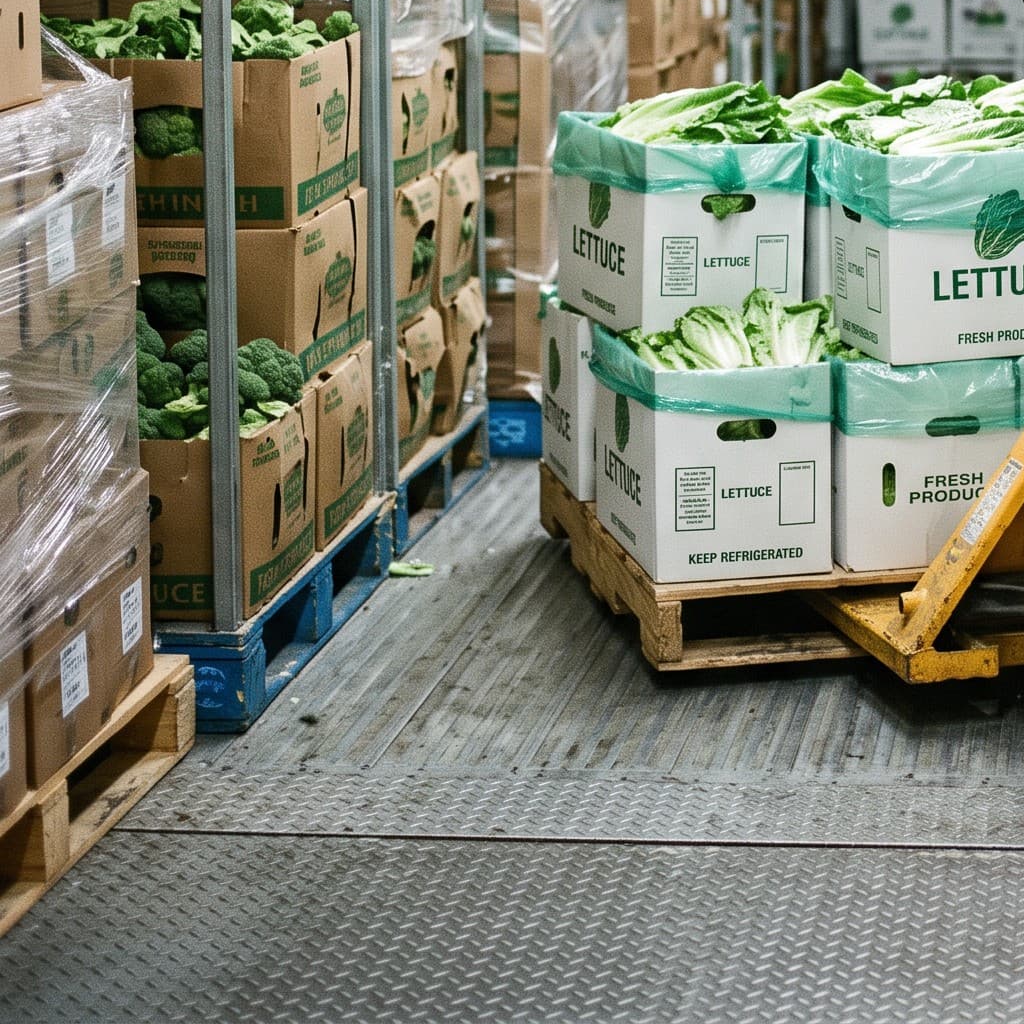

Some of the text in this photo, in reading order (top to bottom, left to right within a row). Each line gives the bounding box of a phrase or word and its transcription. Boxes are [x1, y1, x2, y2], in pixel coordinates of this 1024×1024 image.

[572, 224, 625, 276] LETTUCE
[958, 331, 993, 345] FRESH
[604, 444, 642, 507] LETTUCE
[924, 472, 983, 488] FRESH
[721, 486, 773, 499] LETTUCE
[909, 487, 985, 504] PRODUC
[688, 547, 803, 565] KEEP REFRIGERATED
[153, 583, 206, 603] UCE
